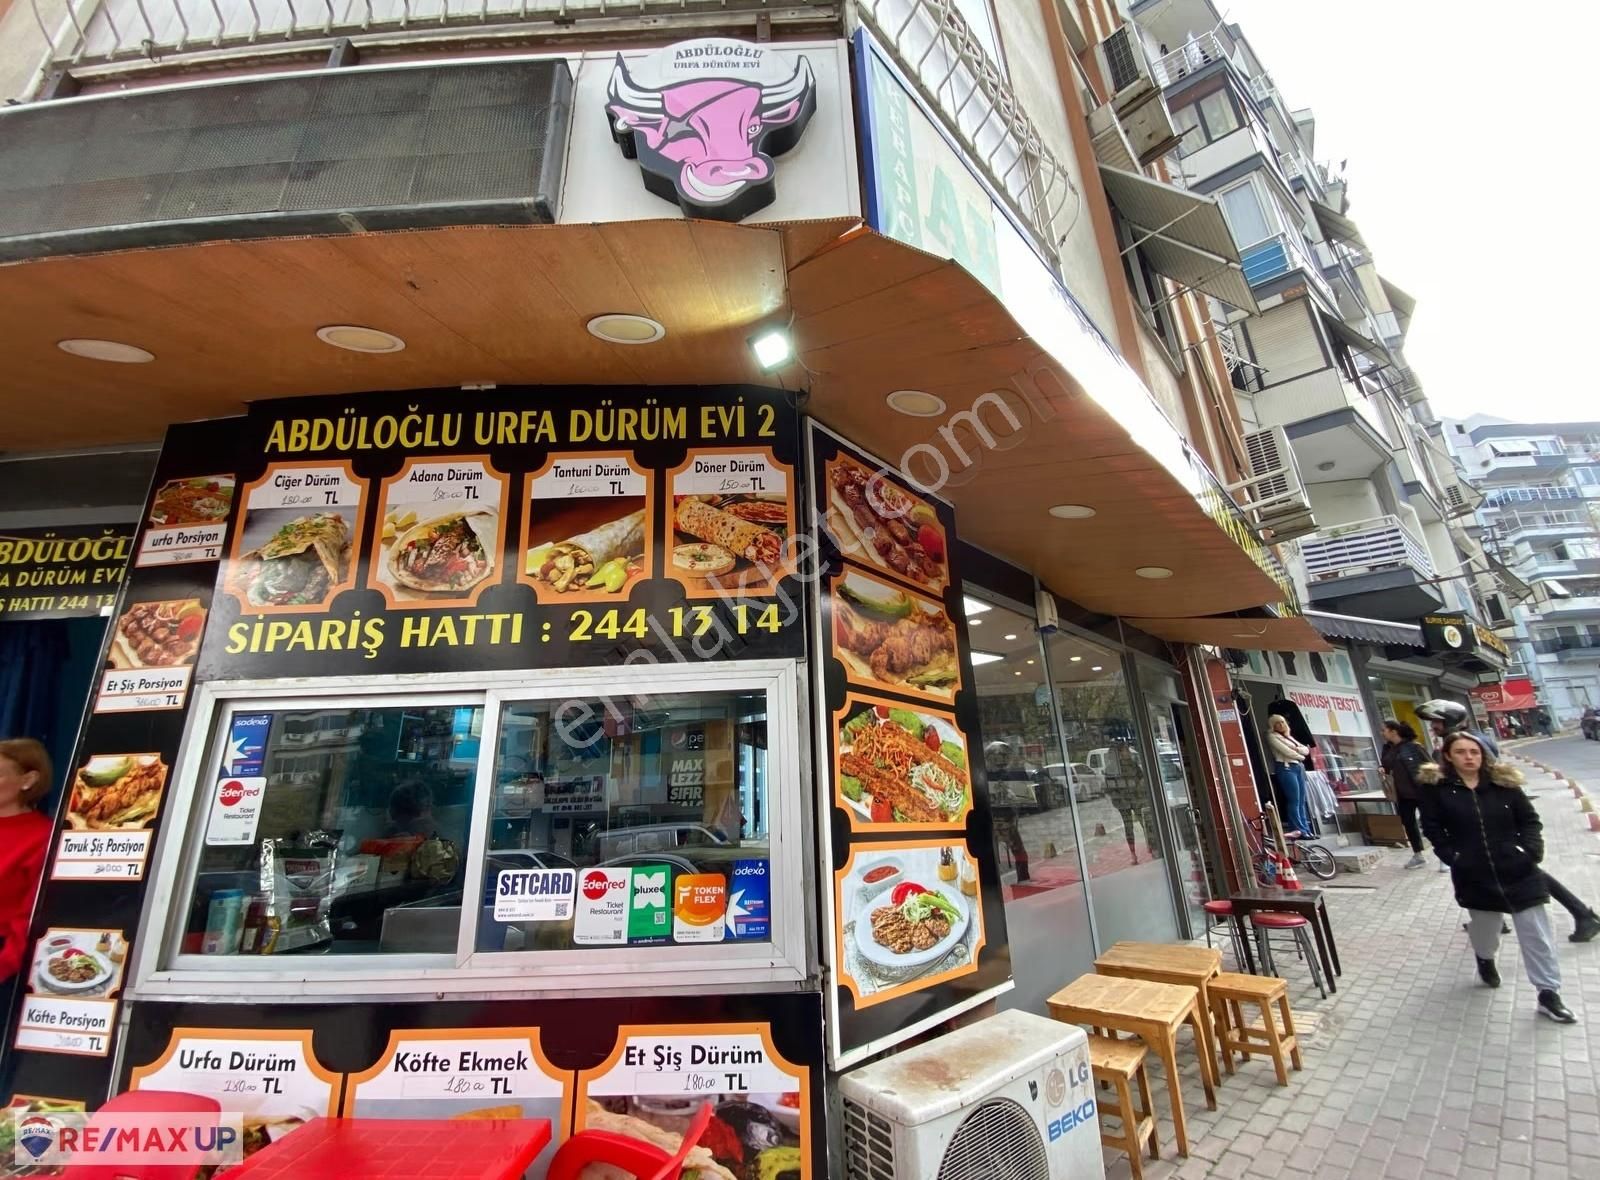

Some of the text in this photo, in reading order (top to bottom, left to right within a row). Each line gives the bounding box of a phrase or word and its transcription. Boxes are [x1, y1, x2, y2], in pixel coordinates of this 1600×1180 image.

[675, 44, 764, 60] ABDÜLOĞLU
[673, 60, 760, 69] URFA DÜRÜM EVİ
[264, 396, 776, 453] ABDÜLOĞLU URFA DÜRÜM EVİ 2
[553, 463, 631, 478] Tantuni Dürüm
[695, 459, 765, 474] Döner Dürüm
[274, 474, 340, 490] Ciğer Dürüm
[409, 468, 483, 483] Adana Dürüm
[609, 481, 625, 495] TL
[750, 477, 766, 491] TL
[324, 491, 339, 505] TL
[464, 486, 479, 500] TL
[152, 530, 219, 547] urfa Porsiyon
[204, 548, 217, 558] TL
[16, 565, 87, 587] DÜRÜM
[92, 563, 126, 584] EVİ
[8, 596, 56, 612] HATTI
[58, 595, 89, 610] 244
[224, 610, 386, 659] SİPARİŞ
[400, 612, 524, 649] HATTI
[568, 608, 649, 642] 244
[667, 604, 714, 637] 13
[732, 603, 782, 634] 14
[106, 677, 183, 693] Et Şiş Porsiyon
[166, 694, 179, 705] TL
[1330, 695, 1363, 713] TEKSTİL
[235, 714, 269, 727] sodexo
[672, 759, 704, 773] MAX
[671, 772, 703, 787] LEZZ
[219, 787, 260, 798] Edenred
[670, 786, 703, 800] SIFIR
[64, 838, 145, 856] Tavuk Şiş Porsiyon
[127, 863, 140, 876] TL
[499, 872, 574, 896] SETCARD
[583, 878, 626, 890] Edenred
[634, 884, 665, 897] pluxee
[694, 886, 725, 895] TOKEN
[606, 901, 624, 909] Ticket
[694, 895, 716, 904] FLEX
[589, 908, 624, 916] Restaurant
[27, 1008, 106, 1029] Köfte Porsiyon
[89, 1036, 102, 1050] TL
[179, 1049, 297, 1072] Urfa Dürüm
[394, 1050, 529, 1073] Köfte Ekmek
[624, 1044, 763, 1071] Et Şiş Dürüm
[725, 1073, 748, 1091] TL
[1069, 1061, 1089, 1089] LG
[262, 1077, 283, 1094] TL
[490, 1077, 513, 1095] TL
[1048, 1099, 1096, 1142] BEKO
